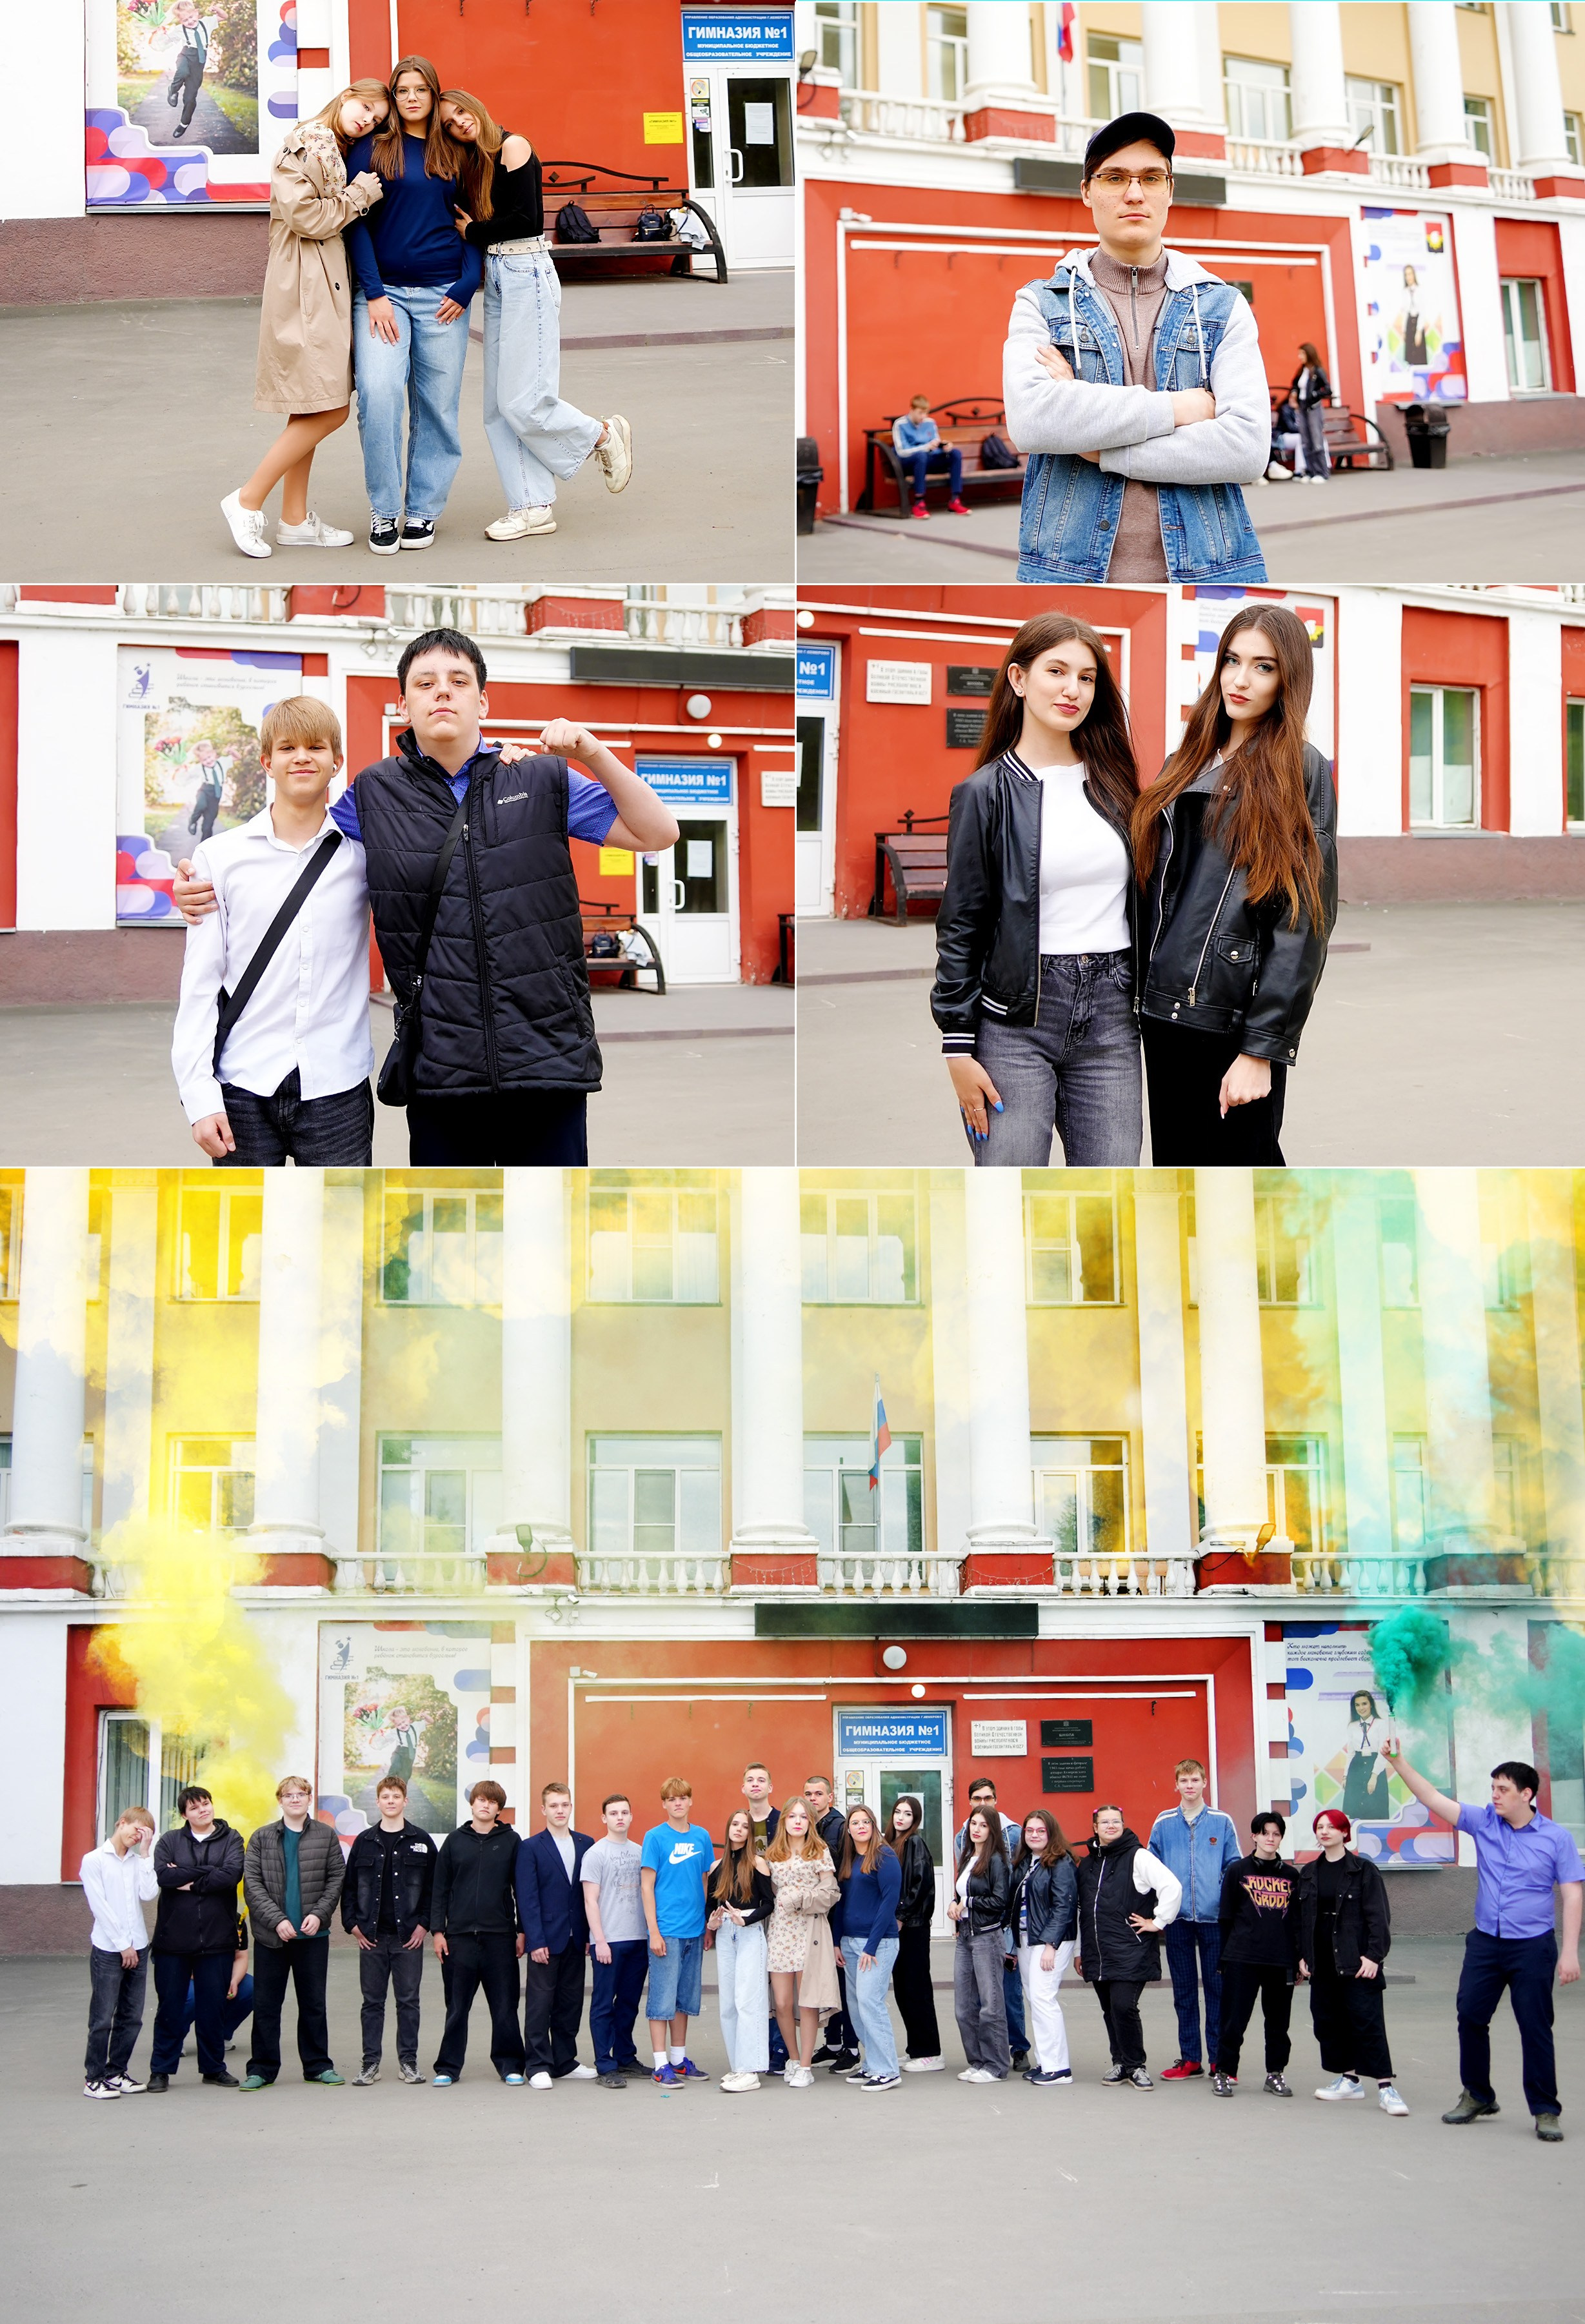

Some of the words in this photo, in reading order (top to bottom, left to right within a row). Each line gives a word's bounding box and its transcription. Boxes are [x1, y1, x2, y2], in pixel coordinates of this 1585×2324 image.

[688, 26, 761, 39] ГИМНАЗИЯ
[765, 26, 787, 39] №1
[799, 661, 825, 676] №1
[641, 774, 704, 786] ГИМНАЗИЯ
[706, 775, 726, 786] №1
[503, 792, 528, 801] Columbia
[846, 1725, 914, 1736] ГИМНАЗИЯ
[919, 1725, 939, 1736] №1
[674, 1843, 694, 1855] NIKE
